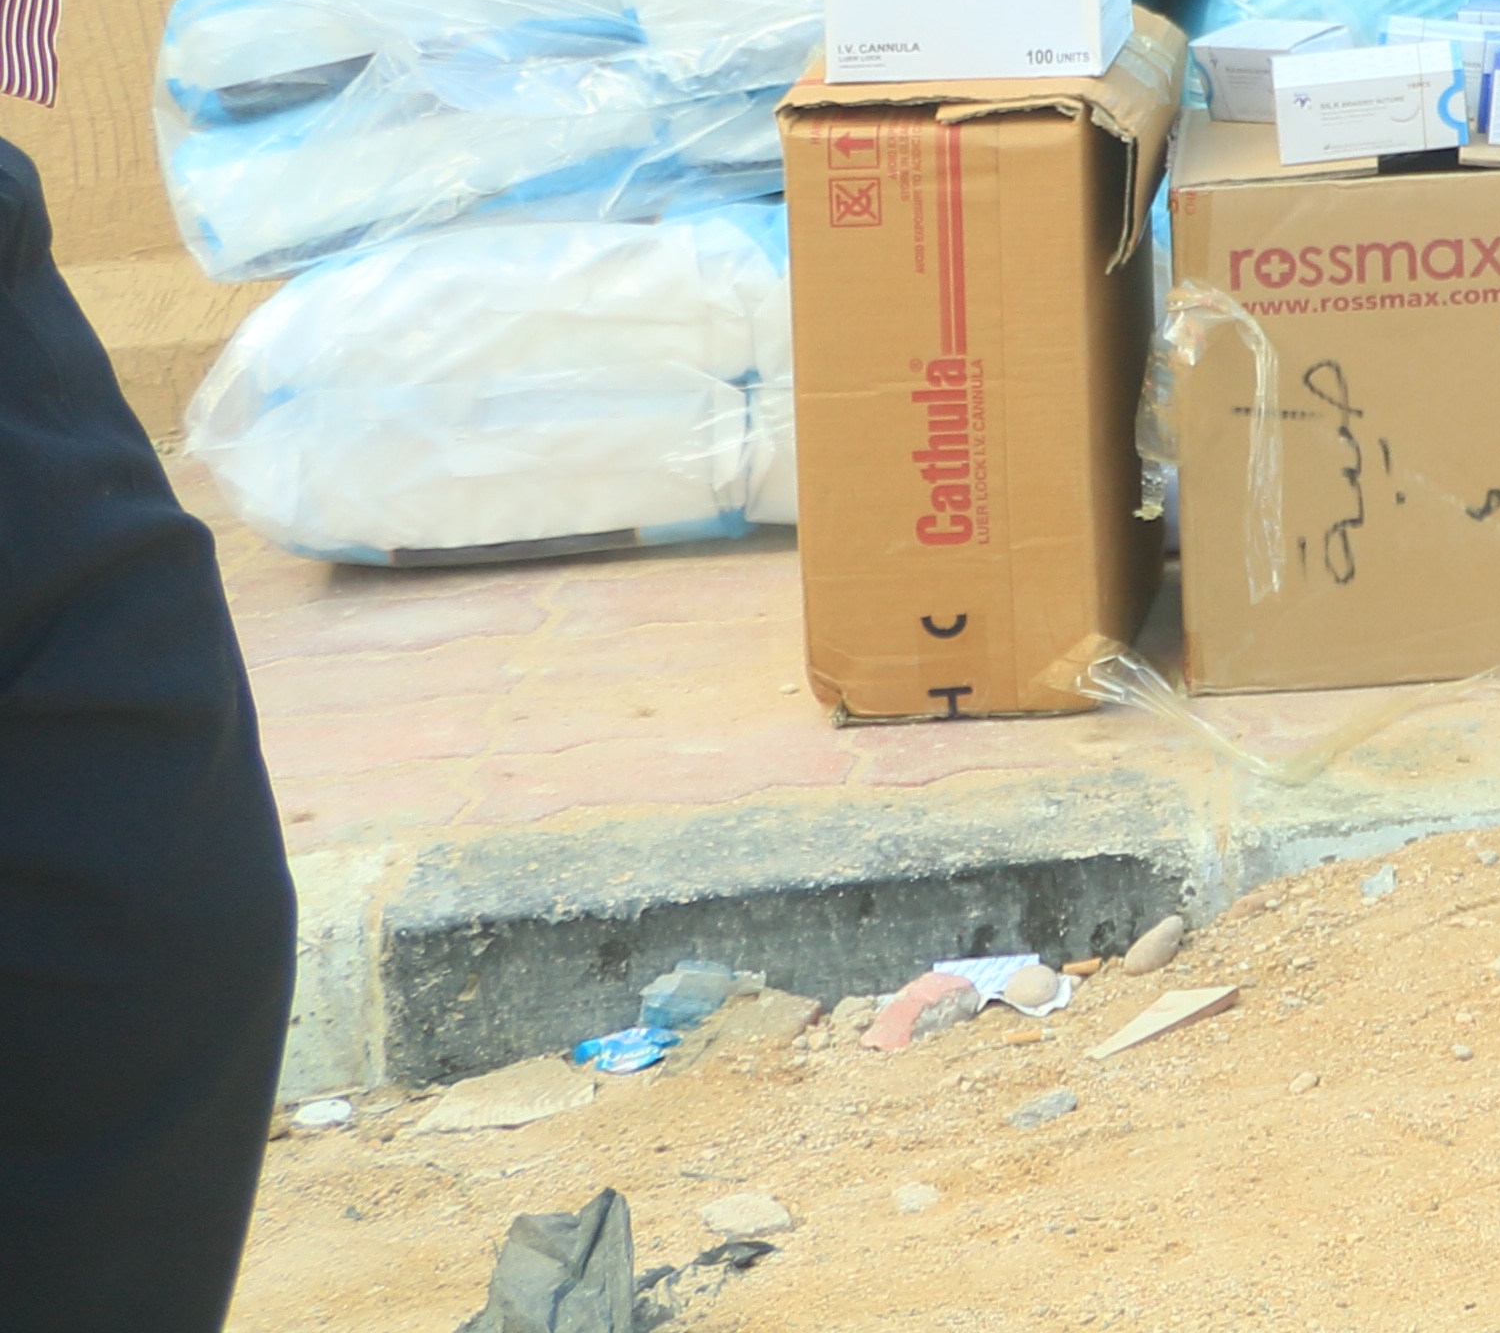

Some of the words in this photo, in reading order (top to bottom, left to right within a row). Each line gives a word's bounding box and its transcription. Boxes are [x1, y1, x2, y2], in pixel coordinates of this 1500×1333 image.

[858, 41, 921, 54] CANNULA
[1026, 49, 1054, 66] 100
[1056, 50, 1090, 65] UNITS
[970, 357, 986, 433] CANNULA
[909, 357, 974, 547] Cathula
[973, 460, 988, 501] LOCK
[975, 505, 990, 545] LUER
